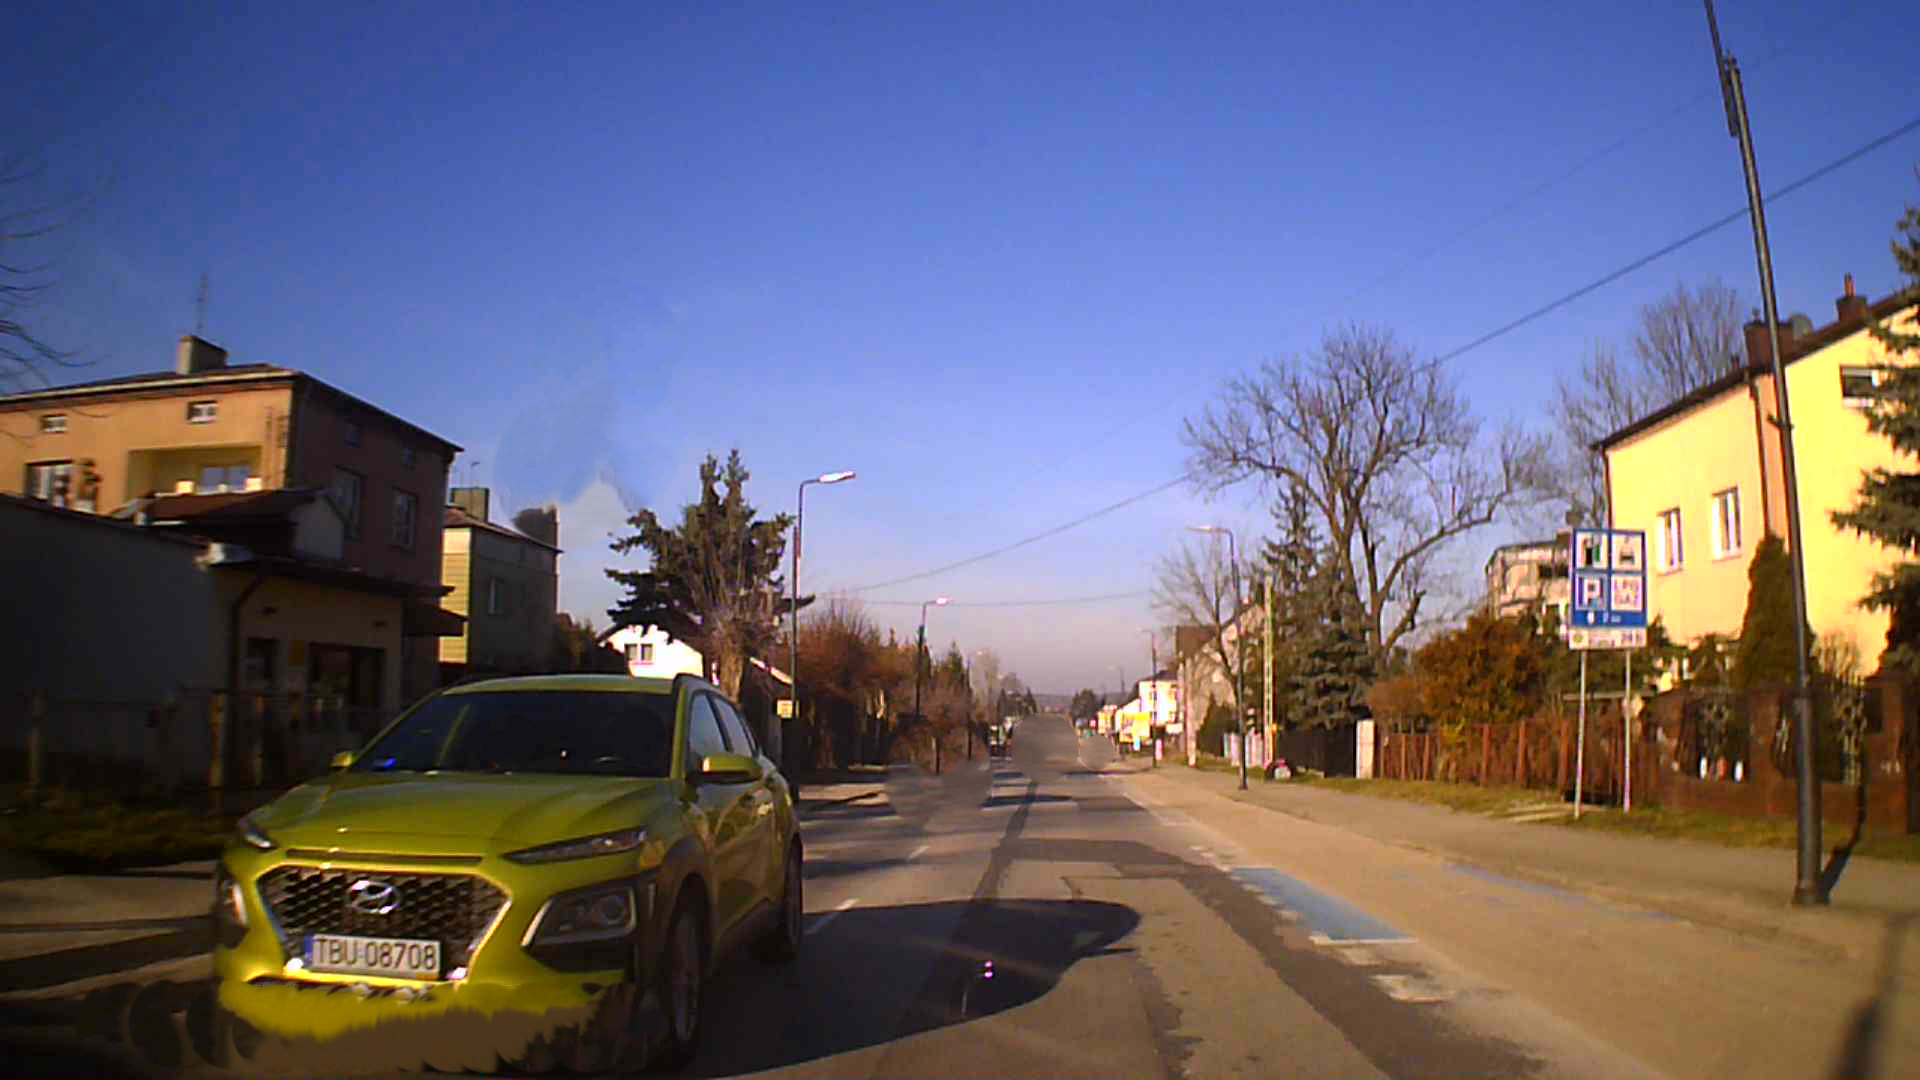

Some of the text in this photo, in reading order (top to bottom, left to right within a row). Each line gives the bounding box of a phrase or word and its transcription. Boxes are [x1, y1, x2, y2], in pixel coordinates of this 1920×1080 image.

[1583, 576, 1601, 606] P
[317, 938, 358, 965] TBU
[366, 941, 437, 970] 08708
